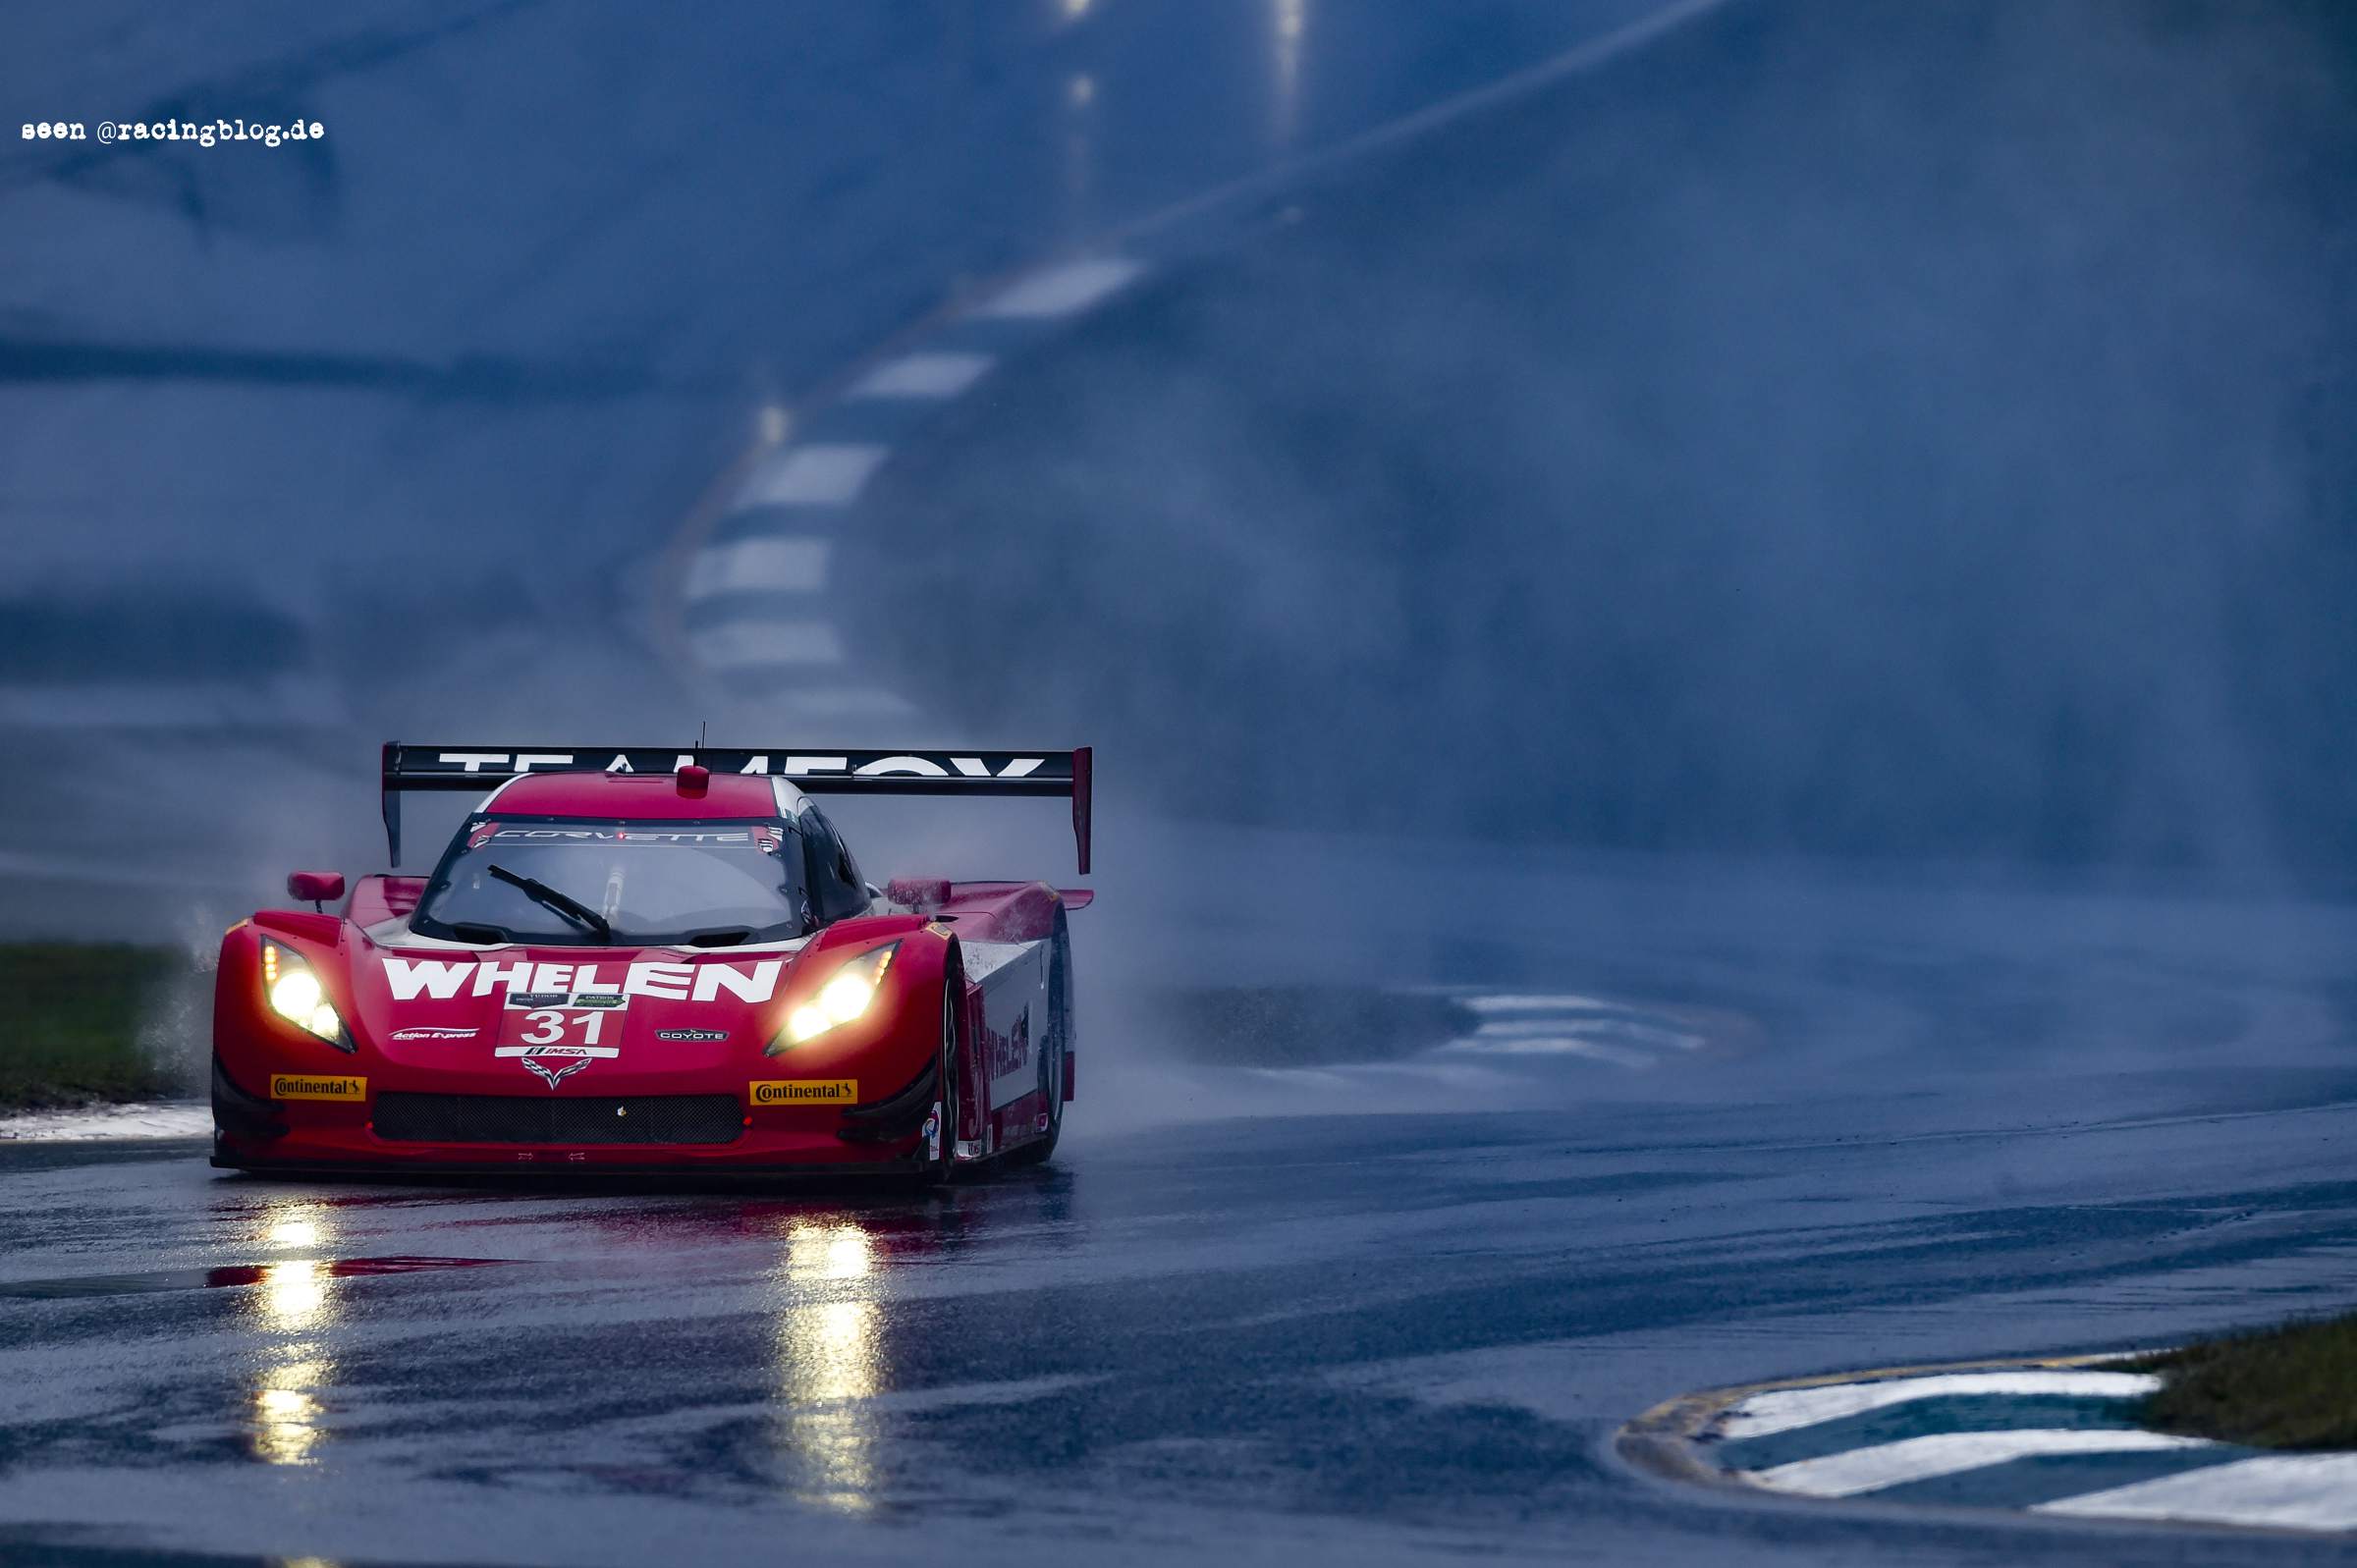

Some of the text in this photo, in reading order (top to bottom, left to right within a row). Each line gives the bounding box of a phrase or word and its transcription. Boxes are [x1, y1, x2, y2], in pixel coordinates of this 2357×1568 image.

[495, 831, 748, 841] CORVETTE
[381, 958, 785, 1003] WHELEN
[521, 1010, 605, 1045] 31
[275, 1078, 347, 1096] Continental
[755, 1083, 841, 1103] Continental
